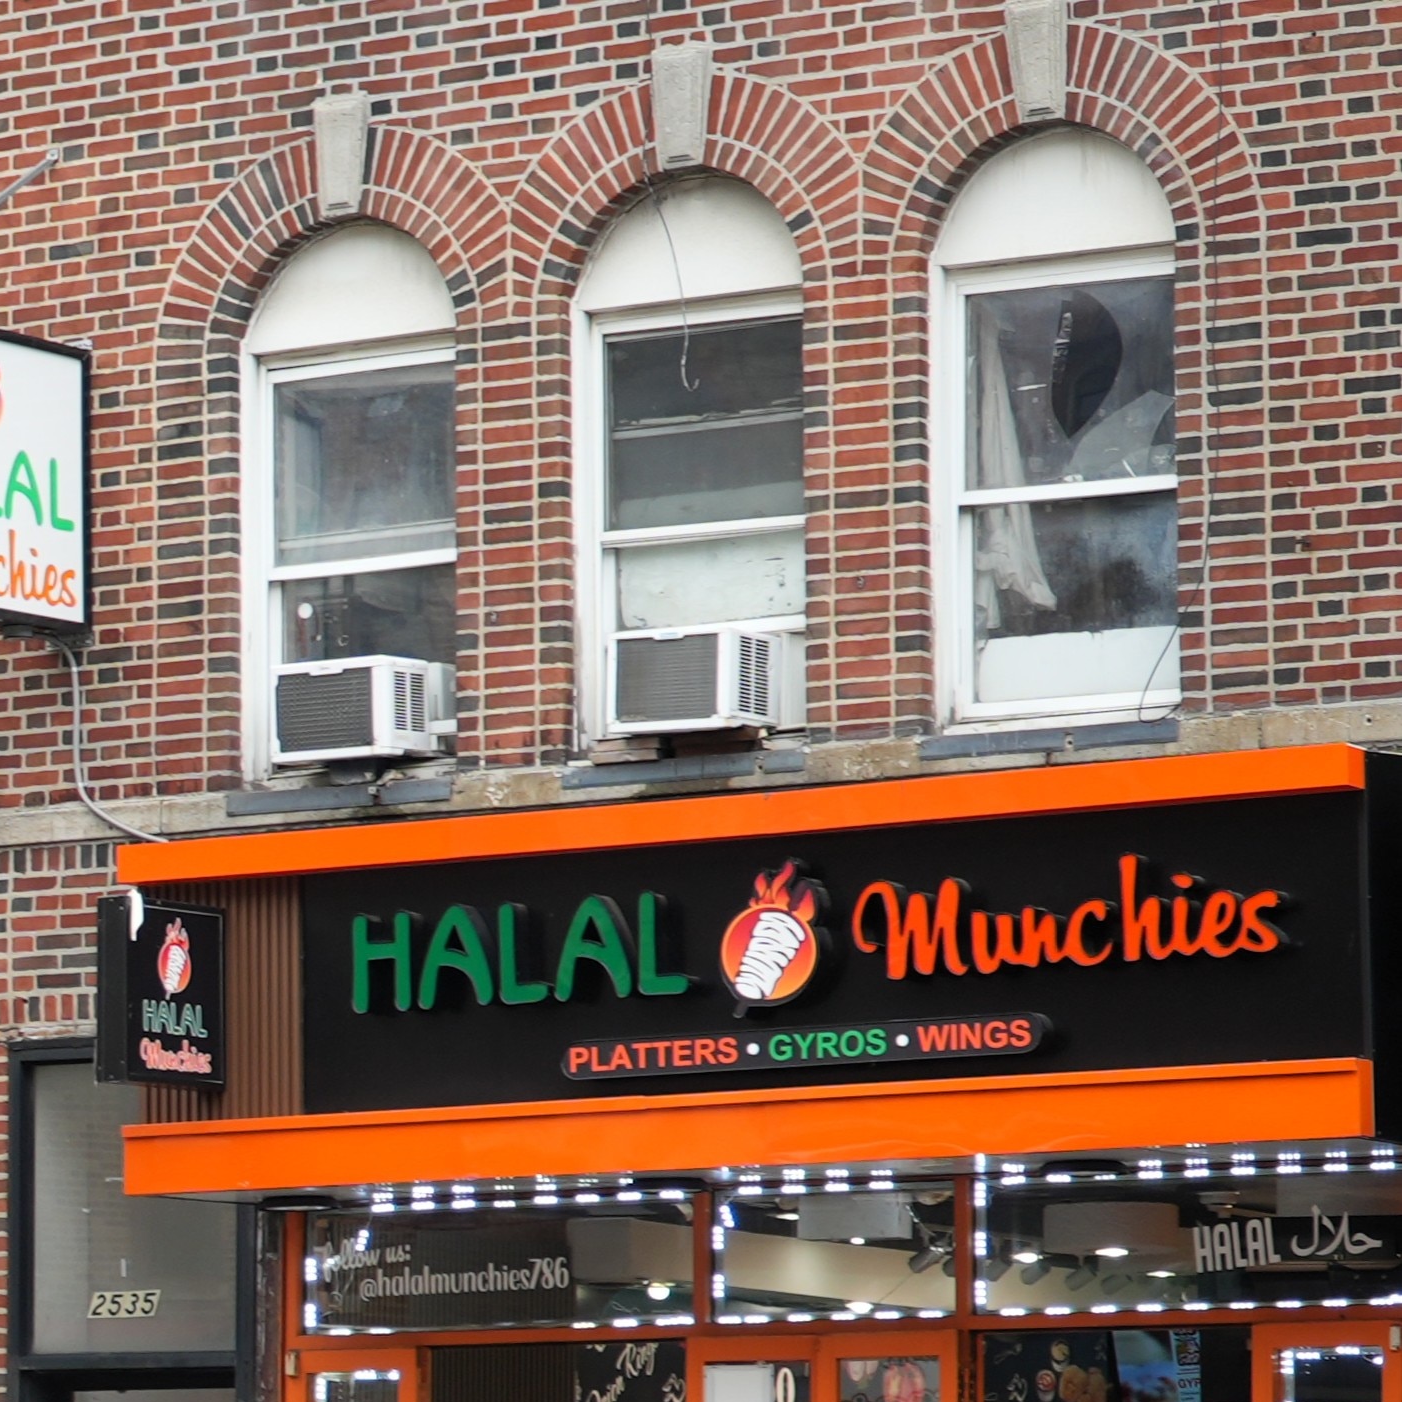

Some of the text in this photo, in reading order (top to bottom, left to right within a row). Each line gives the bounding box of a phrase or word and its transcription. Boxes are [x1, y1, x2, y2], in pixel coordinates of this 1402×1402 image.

[350, 851, 1281, 1015] HALAL Munchies
[142, 999, 208, 1039] HALAL
[139, 1036, 212, 1074] Munchies
[569, 1018, 1032, 1074] PLATTERS GYROS WINGS
[1193, 1217, 1282, 1274] HALAL
[1290, 1204, 1383, 1257] حلال
[385, 1244, 411, 1265] us:
[359, 1257, 570, 1302] @halalmunchies786
[92, 1290, 158, 1316] 2535
